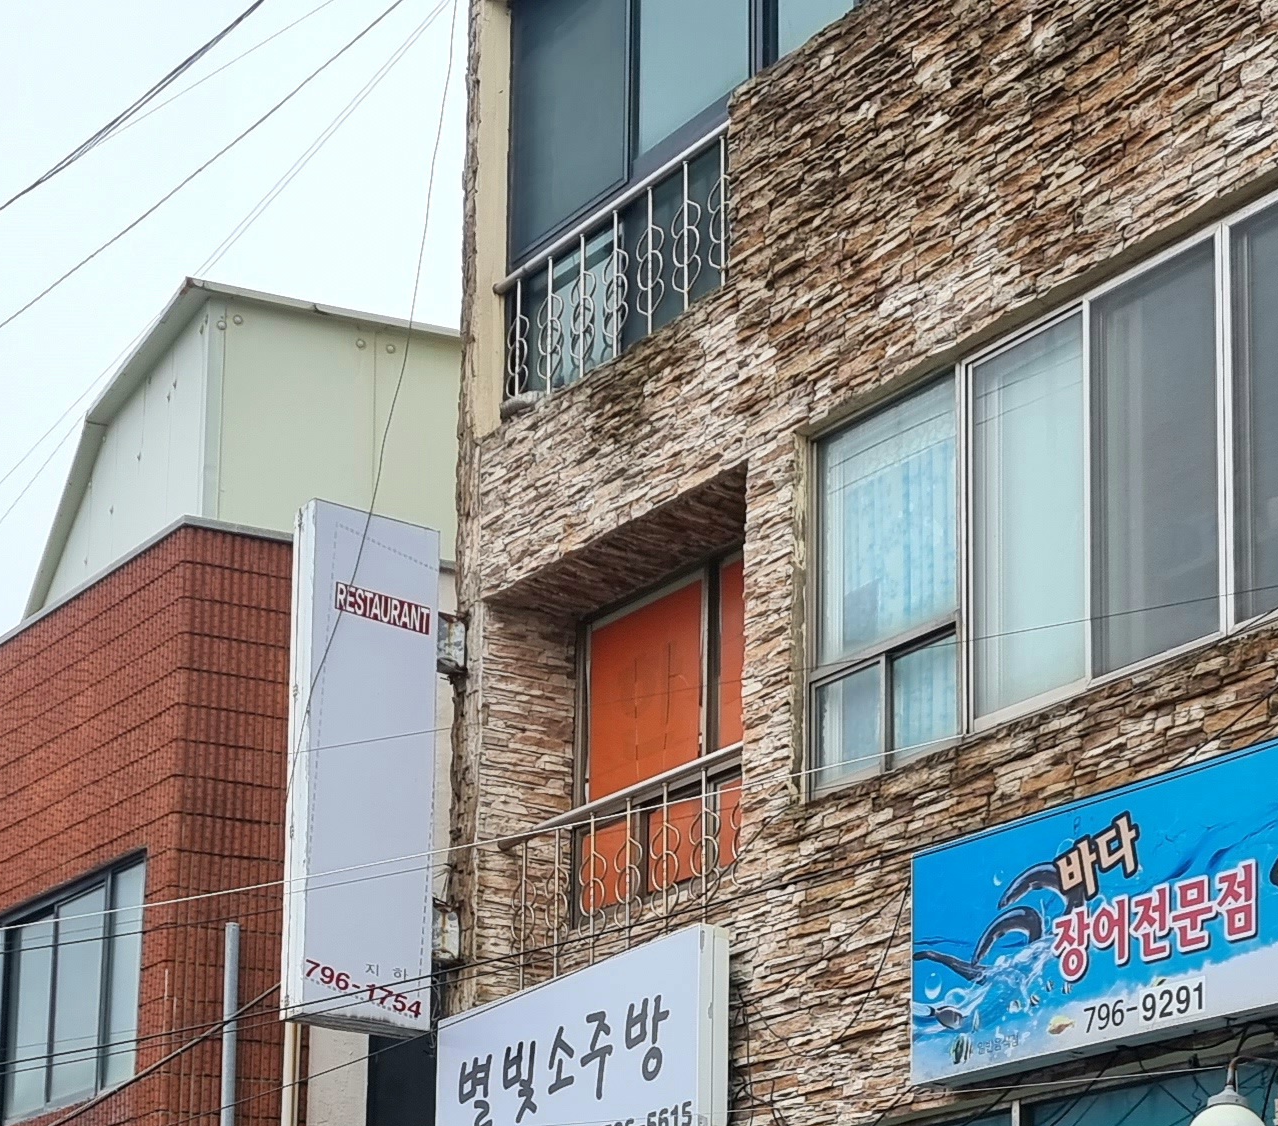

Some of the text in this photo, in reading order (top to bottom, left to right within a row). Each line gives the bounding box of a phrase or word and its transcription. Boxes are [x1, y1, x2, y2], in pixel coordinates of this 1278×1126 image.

[336, 582, 430, 633] RESTAURANT
[1055, 811, 1140, 898] 바다
[1053, 861, 1256, 979] 장어전문점
[305, 959, 422, 1018] 796-1754
[1083, 981, 1204, 1034] 796-9291
